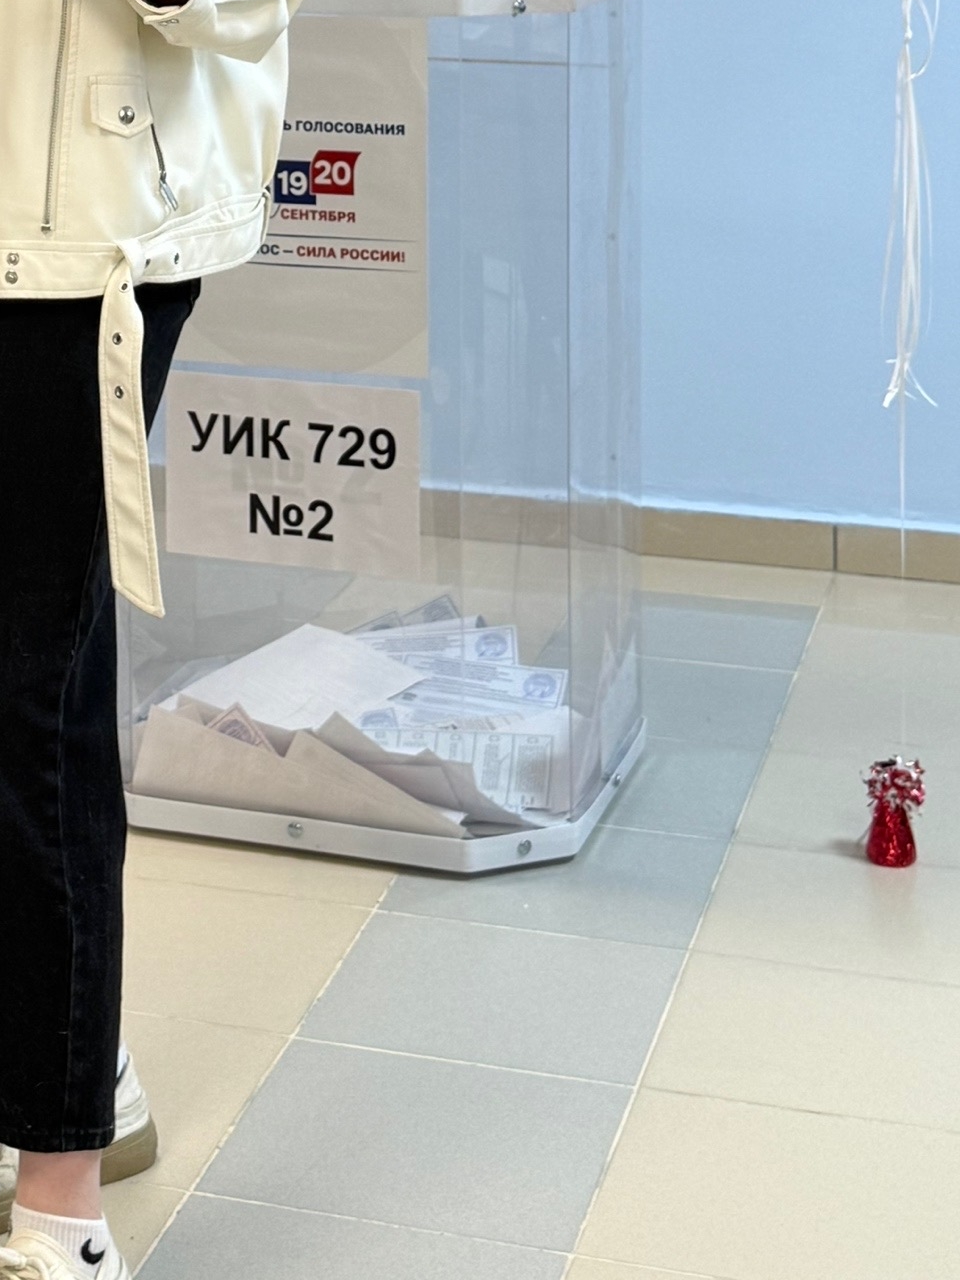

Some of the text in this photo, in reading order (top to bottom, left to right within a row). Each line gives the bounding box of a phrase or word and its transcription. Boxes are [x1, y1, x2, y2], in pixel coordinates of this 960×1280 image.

[295, 120, 406, 136] ГОЛОСОВАНИЯ
[276, 159, 352, 197] 19 20
[280, 208, 356, 223] СЕНТЯБРЯ
[296, 245, 337, 259] СИЛА
[340, 247, 406, 263] РОССИИ!
[187, 410, 397, 471] УИК 729
[249, 492, 335, 543] №2
